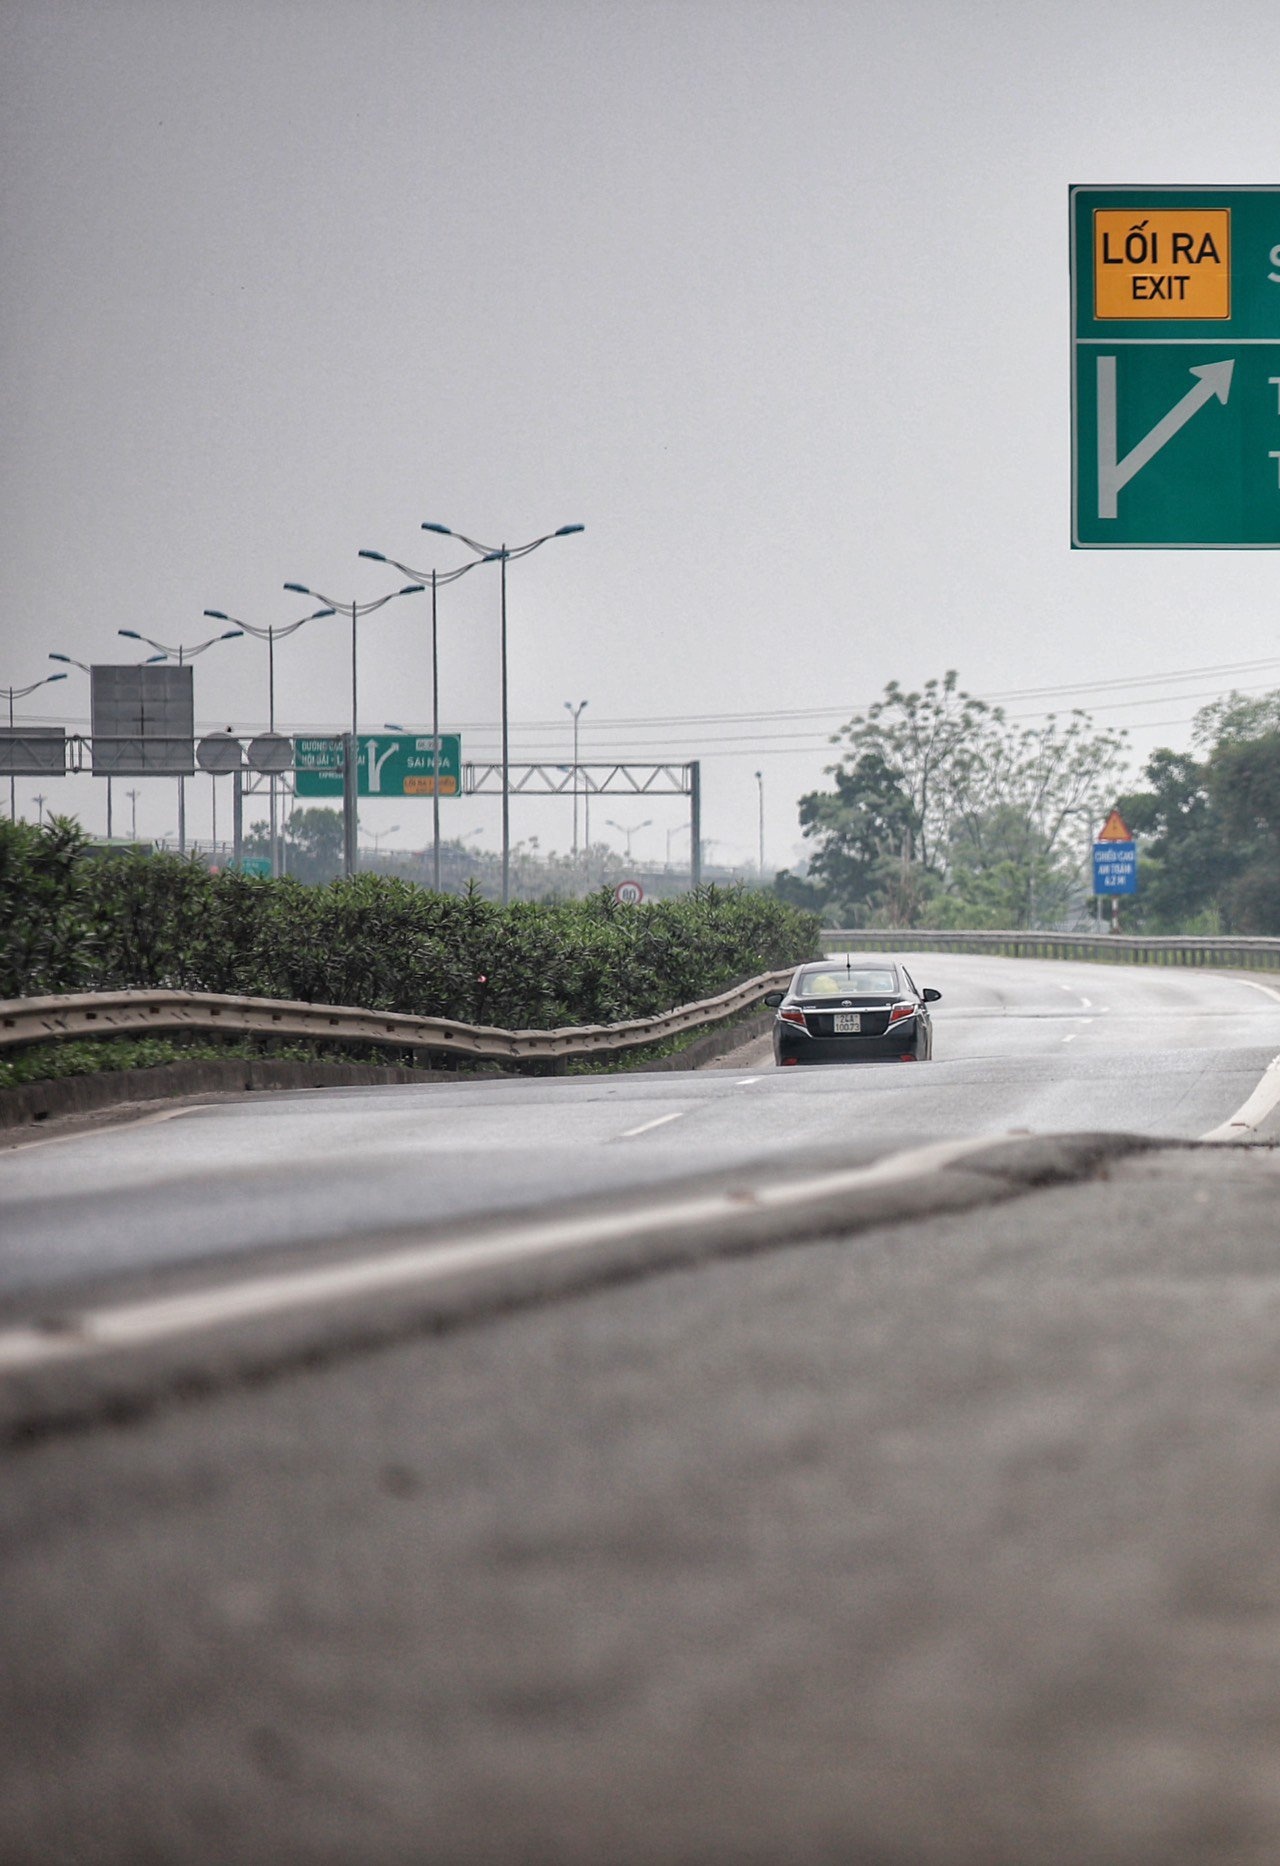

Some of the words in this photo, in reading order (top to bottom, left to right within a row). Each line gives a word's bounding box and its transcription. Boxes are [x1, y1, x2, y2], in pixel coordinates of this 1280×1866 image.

[1102, 219, 1159, 265] LỐI
[1171, 232, 1221, 265] RA
[1131, 275, 1191, 301] EXIT
[426, 756, 450, 768] NA
